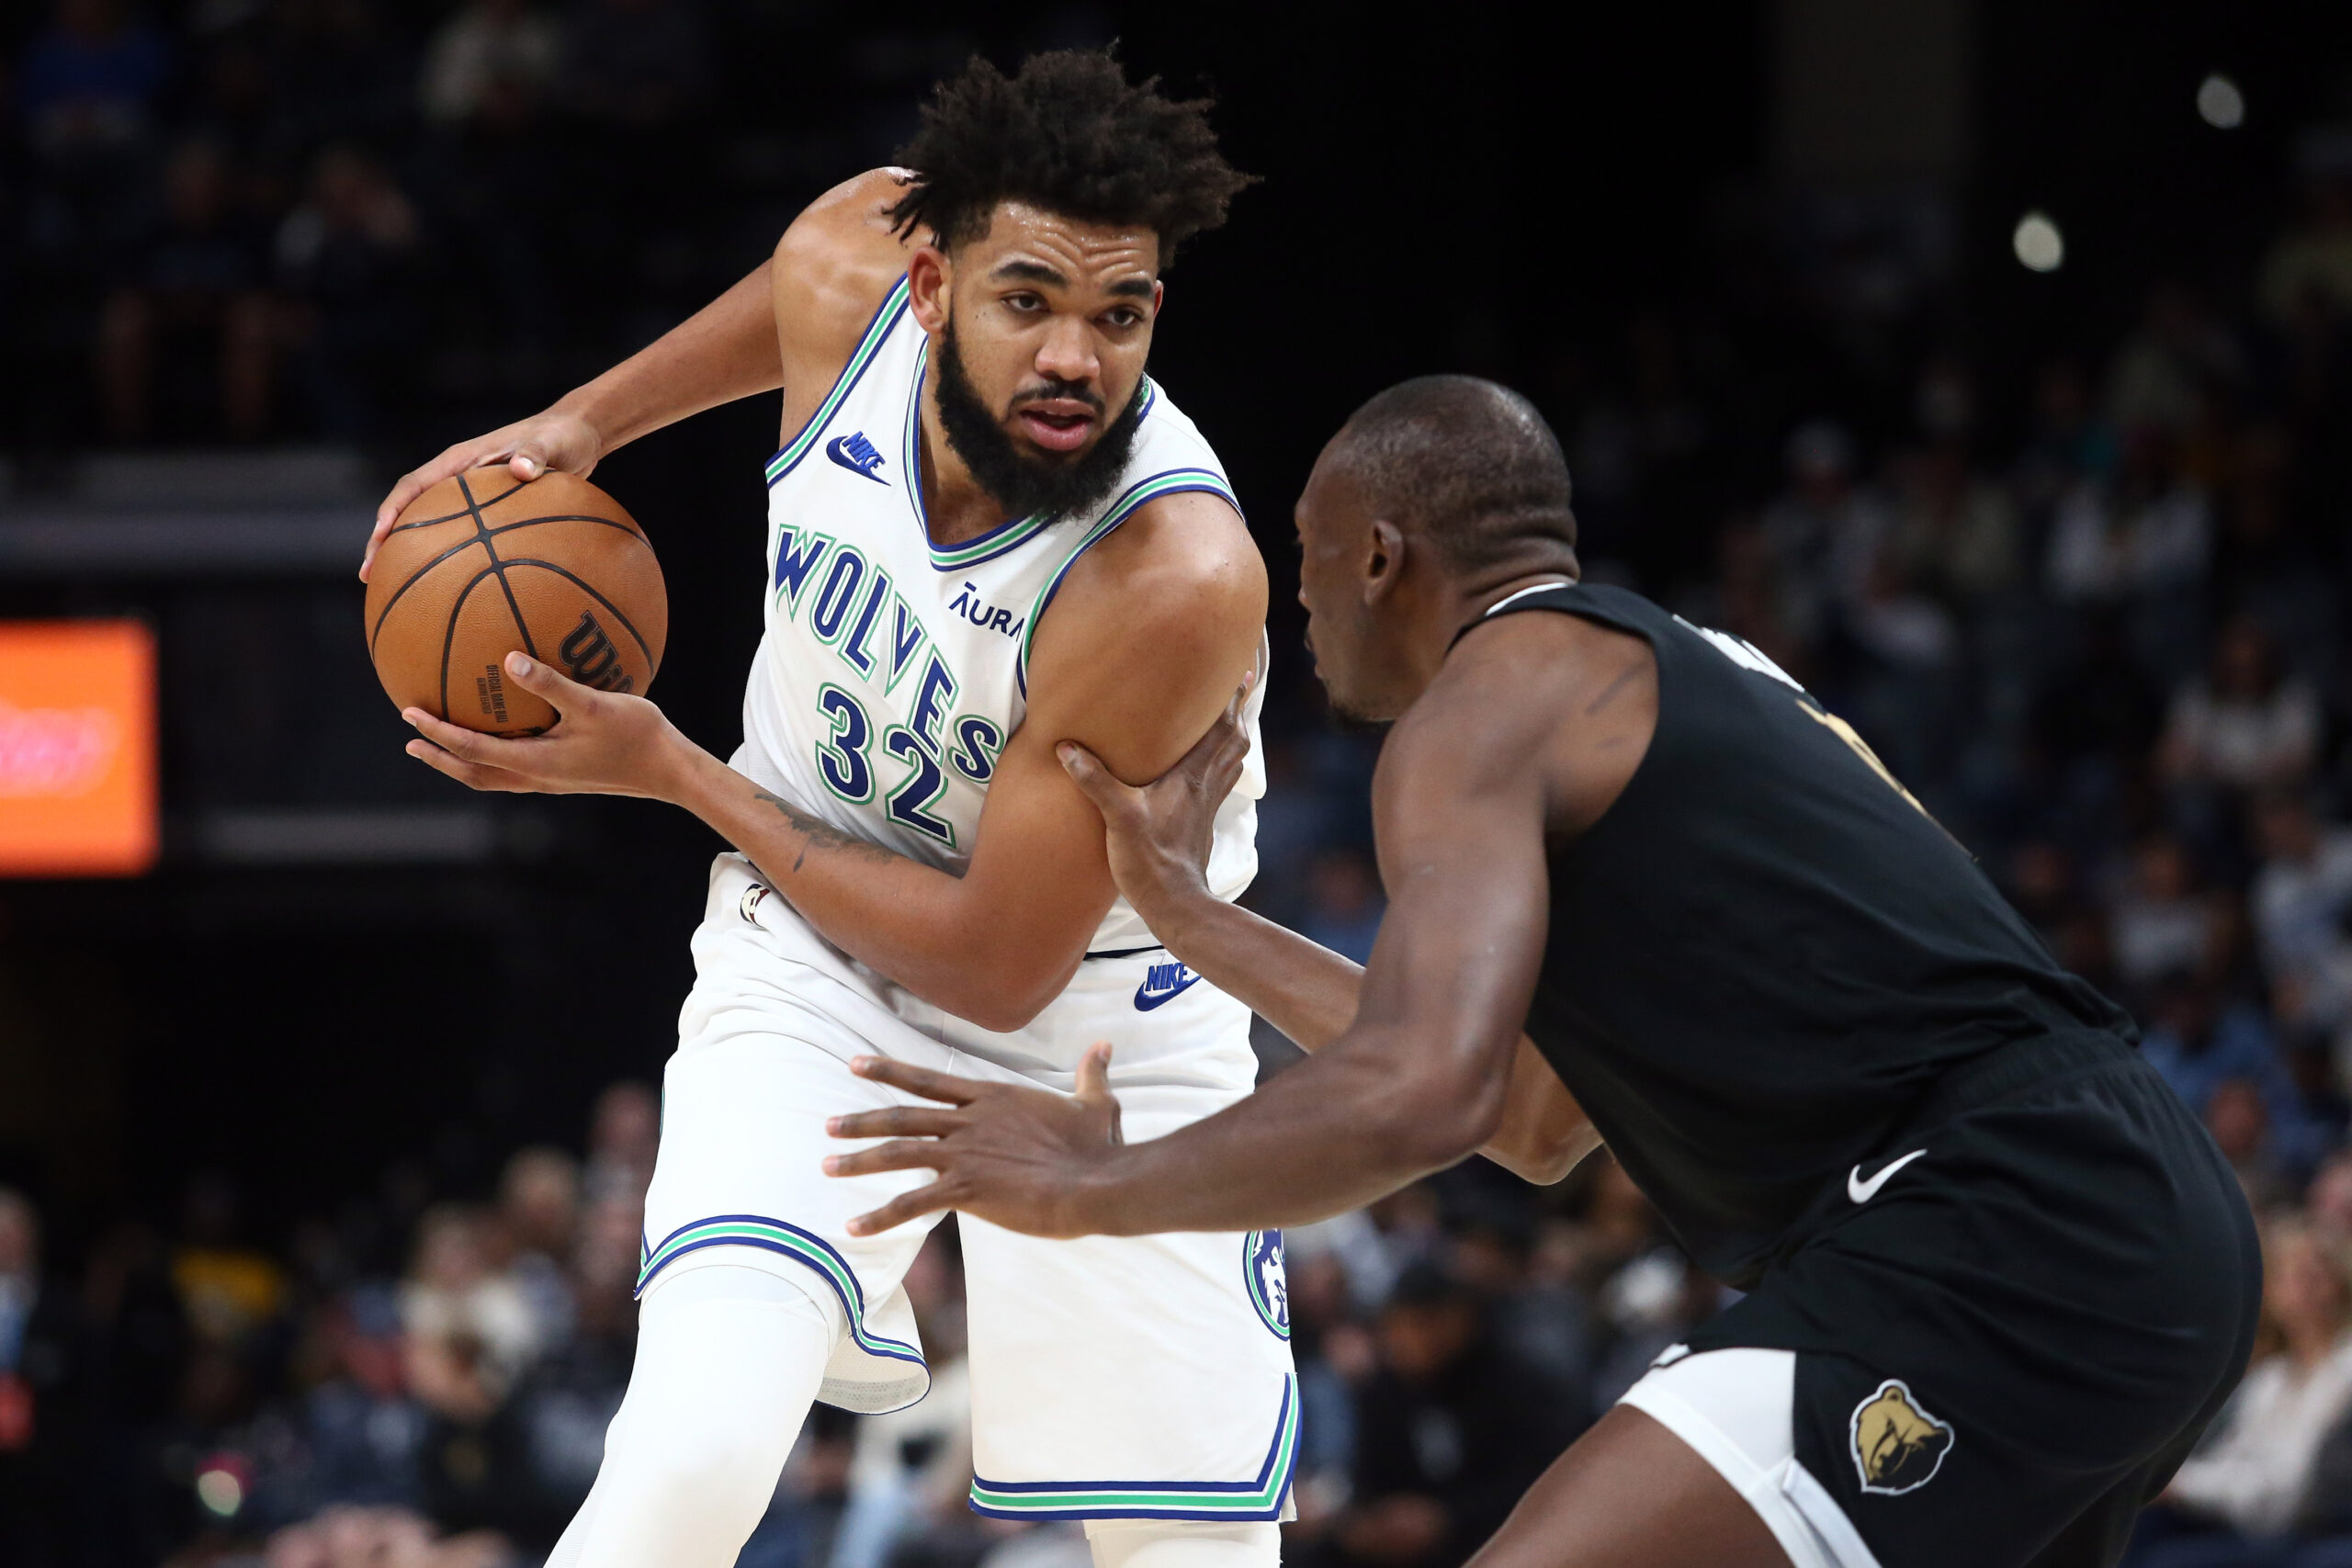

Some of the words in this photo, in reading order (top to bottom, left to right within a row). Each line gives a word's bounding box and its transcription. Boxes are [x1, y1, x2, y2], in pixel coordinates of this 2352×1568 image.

[842, 431, 886, 475] NIKE
[775, 524, 1004, 784] WOLVES
[486, 664, 502, 692] OFFICIAL
[815, 682, 956, 848] 32
[1145, 962, 1188, 991] NIKE
